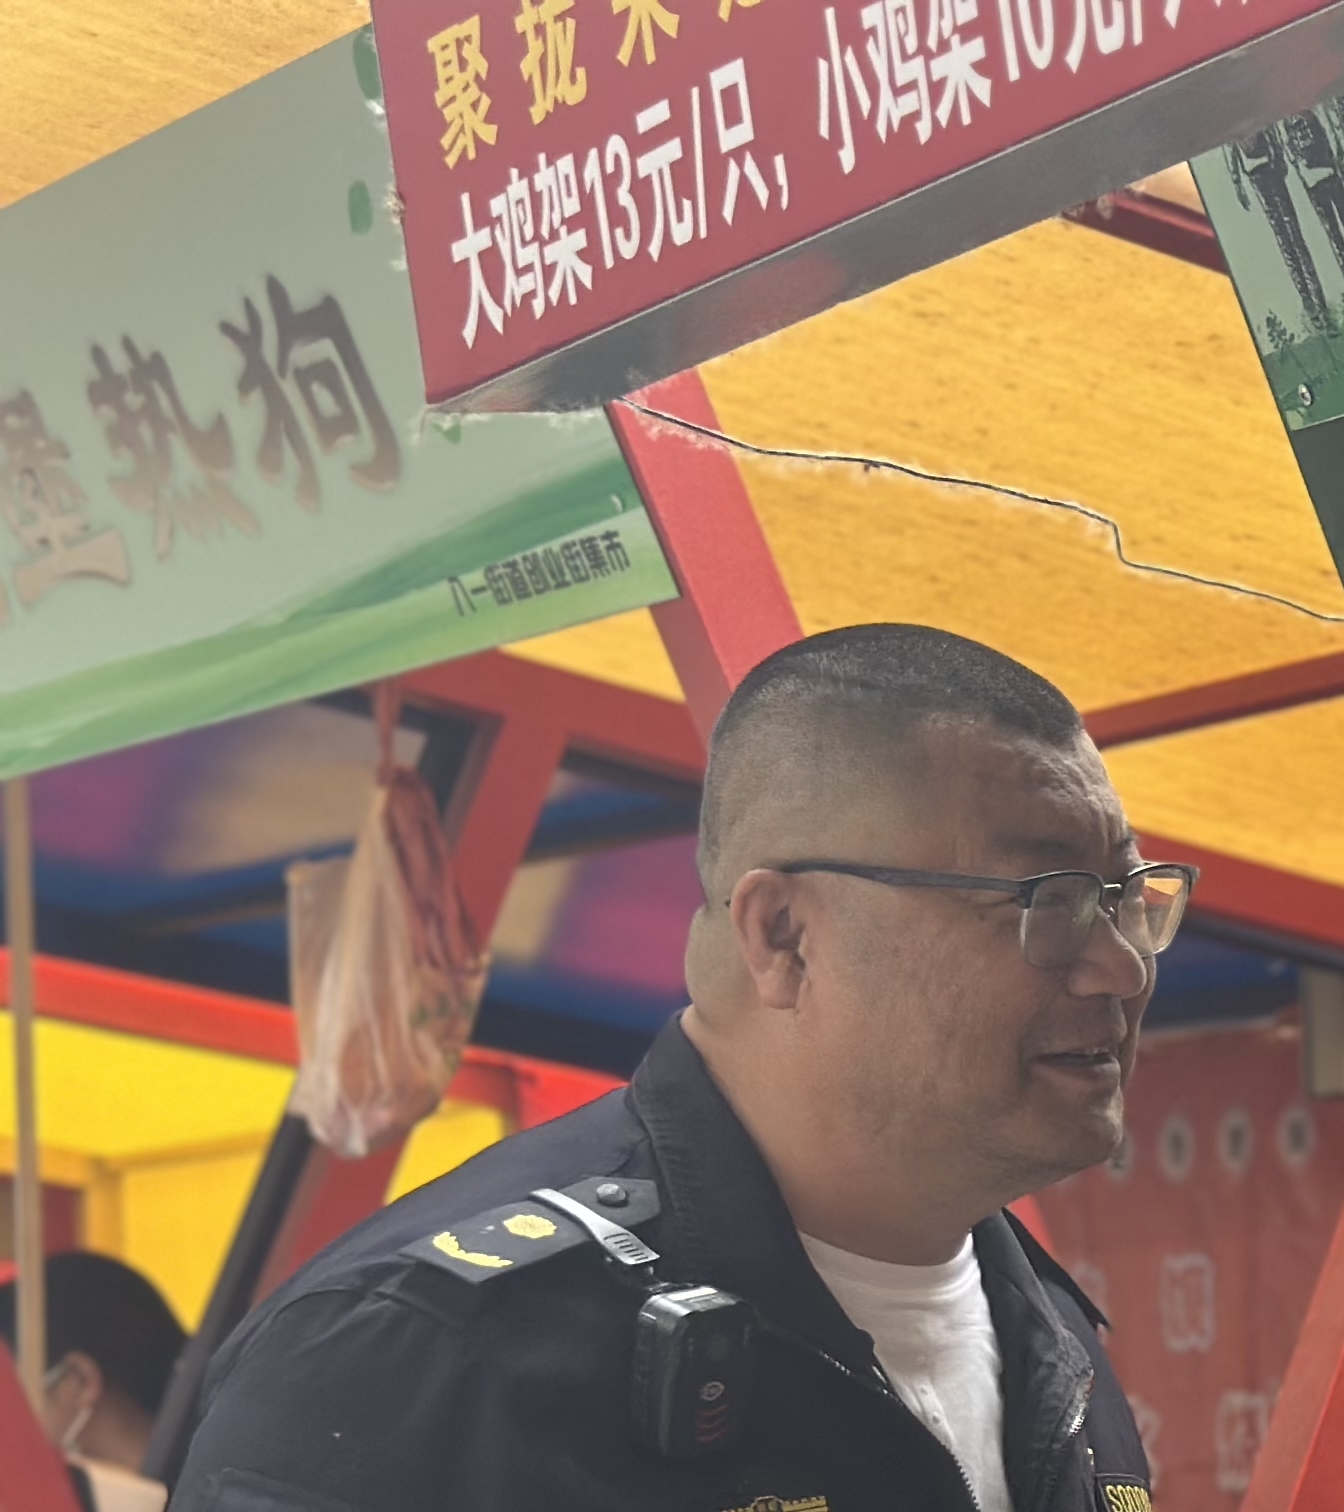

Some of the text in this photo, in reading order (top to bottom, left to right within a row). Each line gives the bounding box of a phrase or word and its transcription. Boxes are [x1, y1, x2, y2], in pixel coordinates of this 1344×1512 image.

[427, 0, 763, 169] 聚拢
[0, 272, 402, 614] 堡热狗
